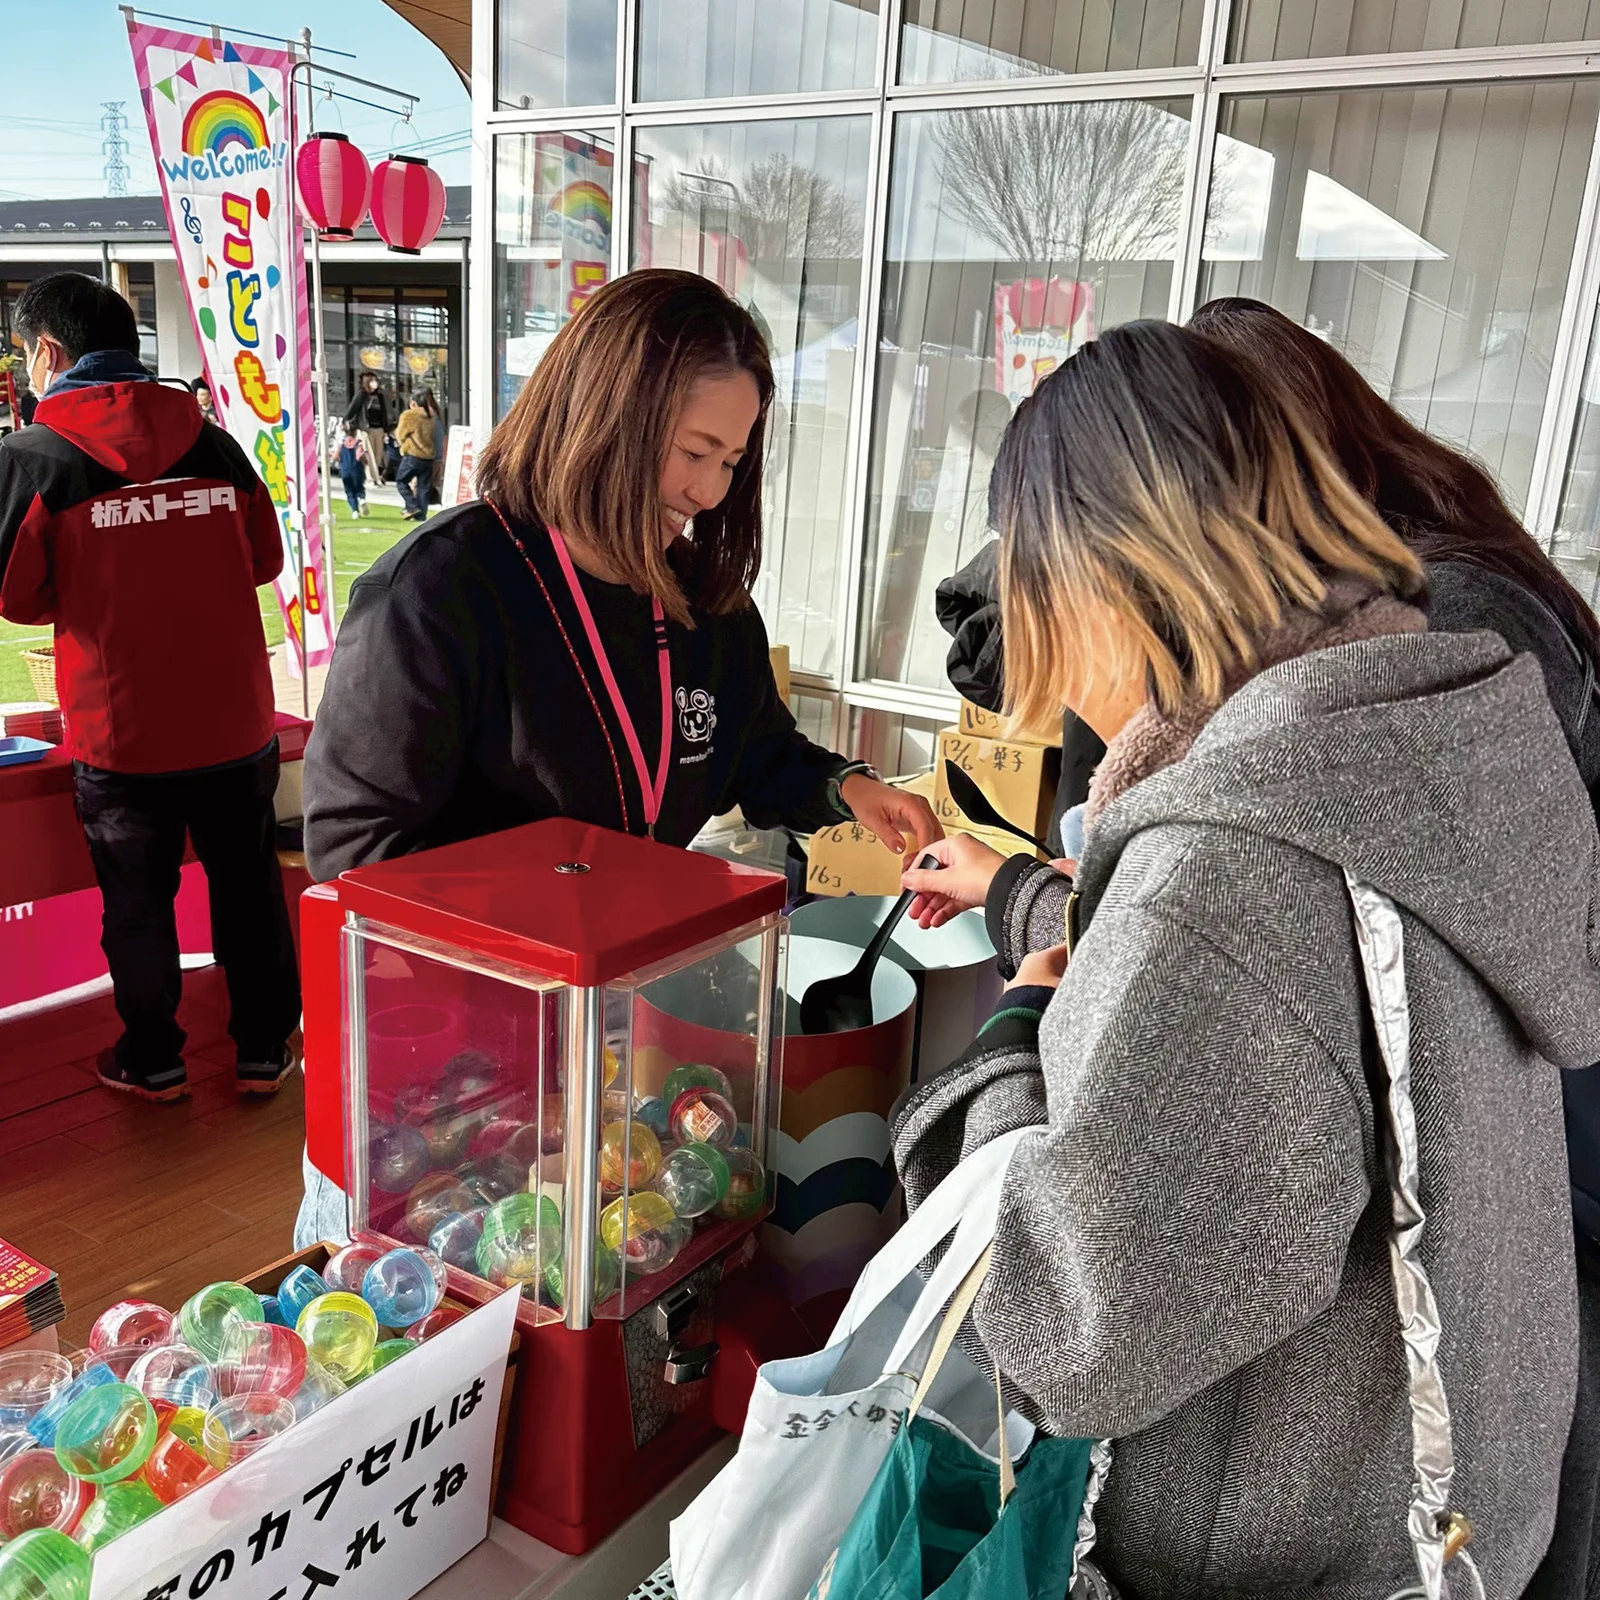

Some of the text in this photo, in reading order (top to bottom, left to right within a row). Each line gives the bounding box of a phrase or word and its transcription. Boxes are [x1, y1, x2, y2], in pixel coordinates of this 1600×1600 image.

[161, 142, 287, 183] Welcome!!
[91, 486, 237, 528] 栃木トヨタ
[266, 1462, 468, 1600] 入れてね
